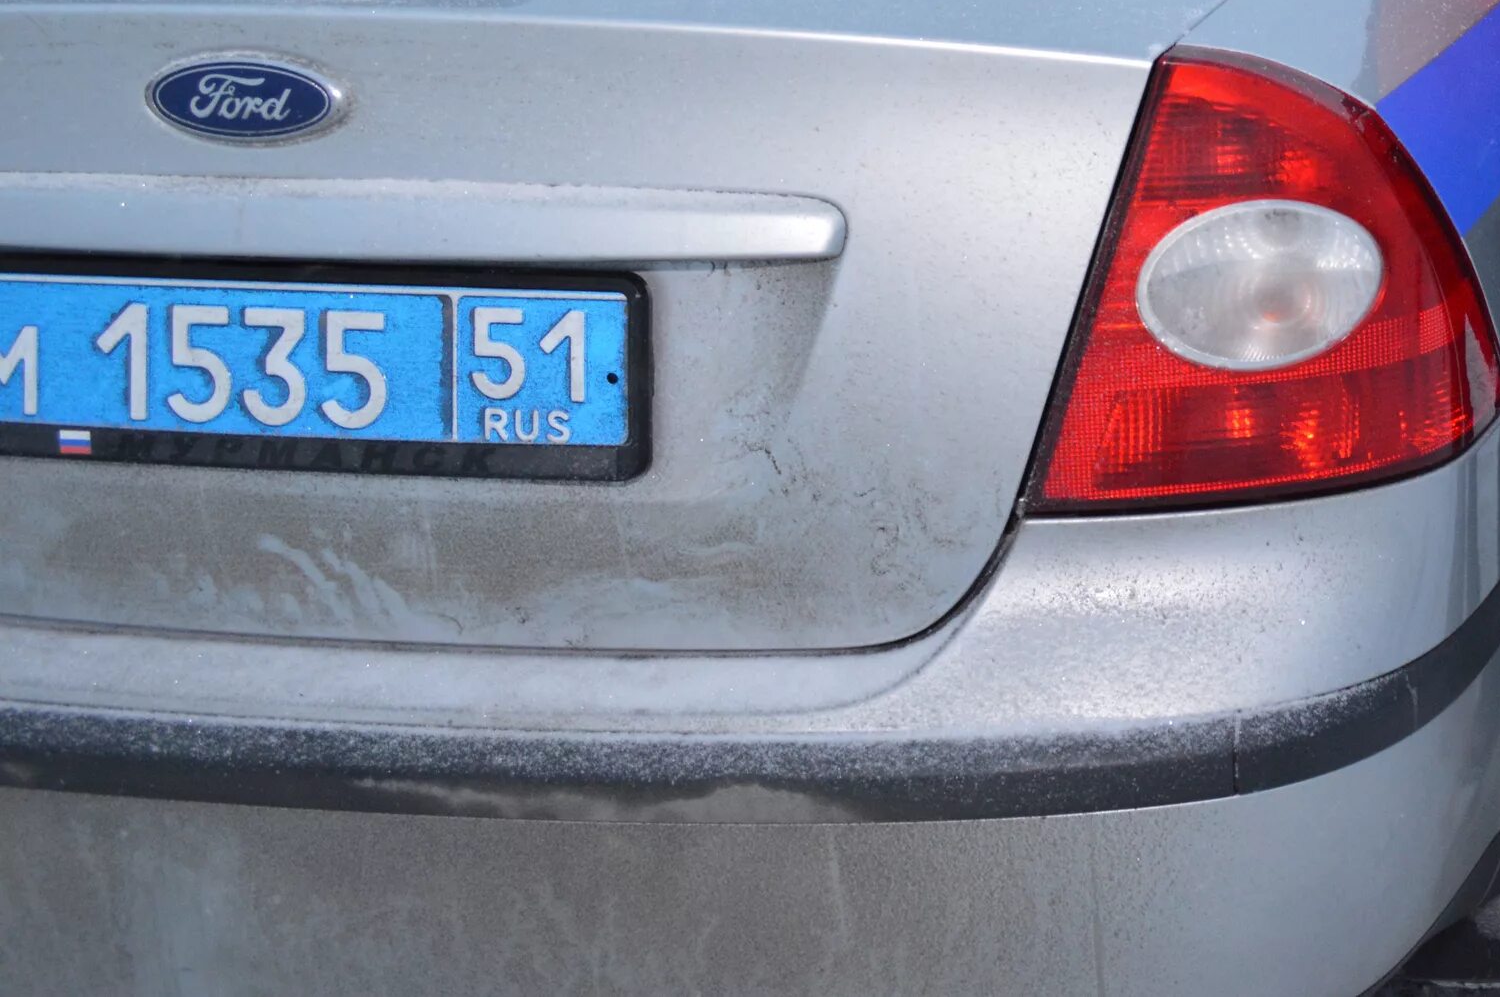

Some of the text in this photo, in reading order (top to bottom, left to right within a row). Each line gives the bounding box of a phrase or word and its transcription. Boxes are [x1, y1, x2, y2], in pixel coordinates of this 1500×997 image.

[190, 72, 292, 123] Ford
[95, 301, 389, 430] 1535
[469, 305, 586, 403] 51
[483, 405, 572, 443] RUS
